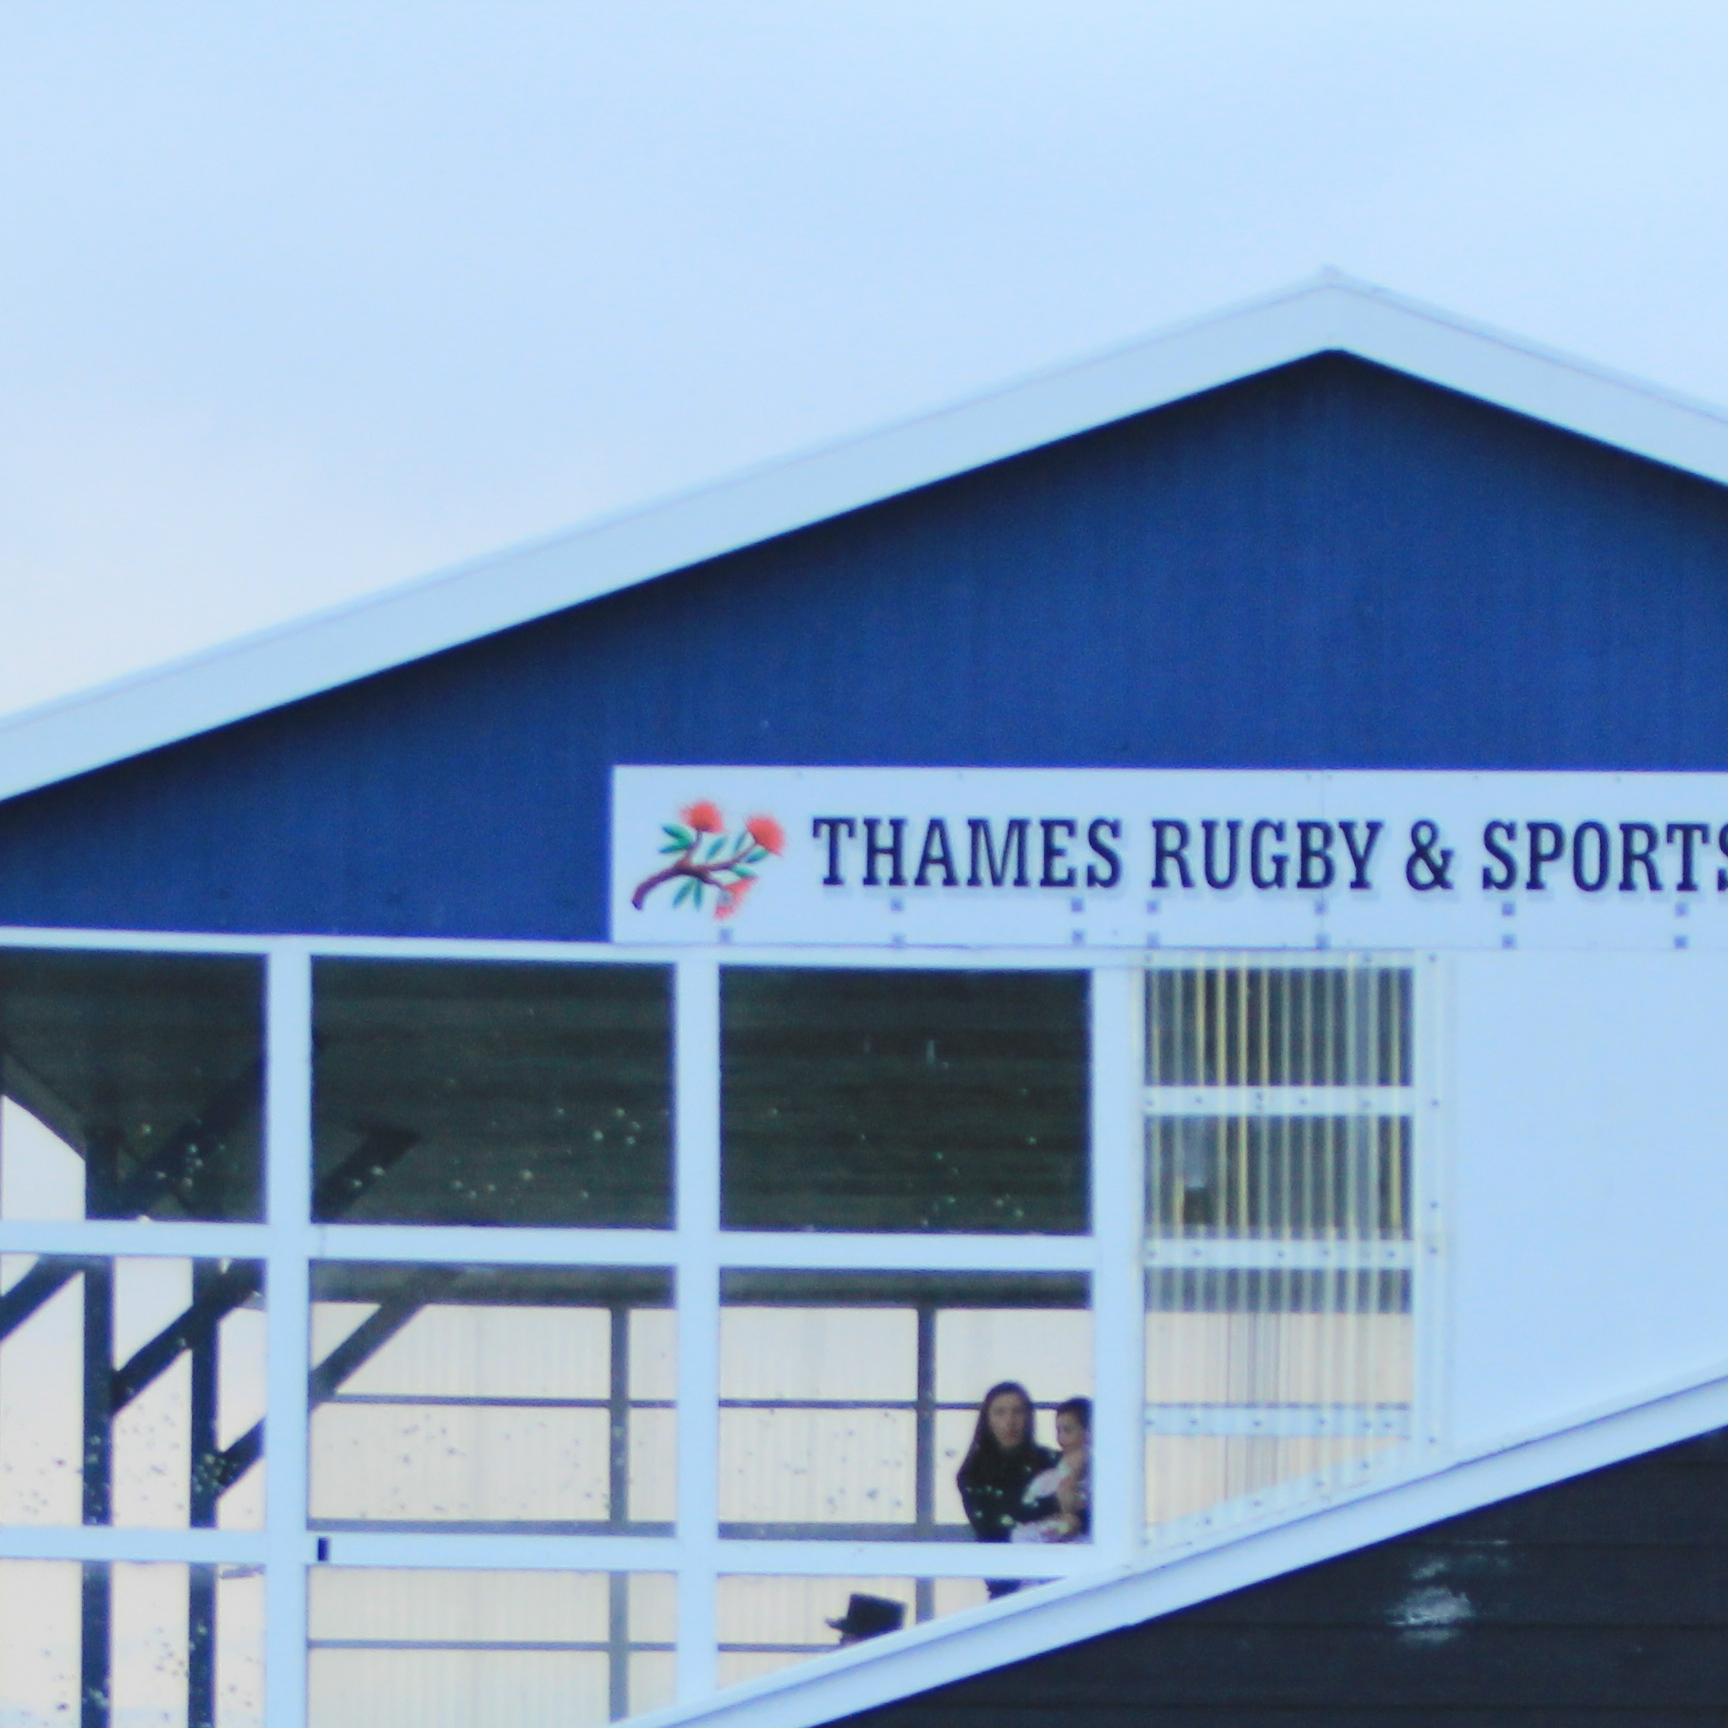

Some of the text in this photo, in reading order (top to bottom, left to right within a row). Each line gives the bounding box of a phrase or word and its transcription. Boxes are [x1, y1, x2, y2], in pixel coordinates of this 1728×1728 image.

[811, 817, 1122, 888] THAMES
[1151, 818, 1384, 891] RUGBY
[1405, 818, 1455, 892] &
